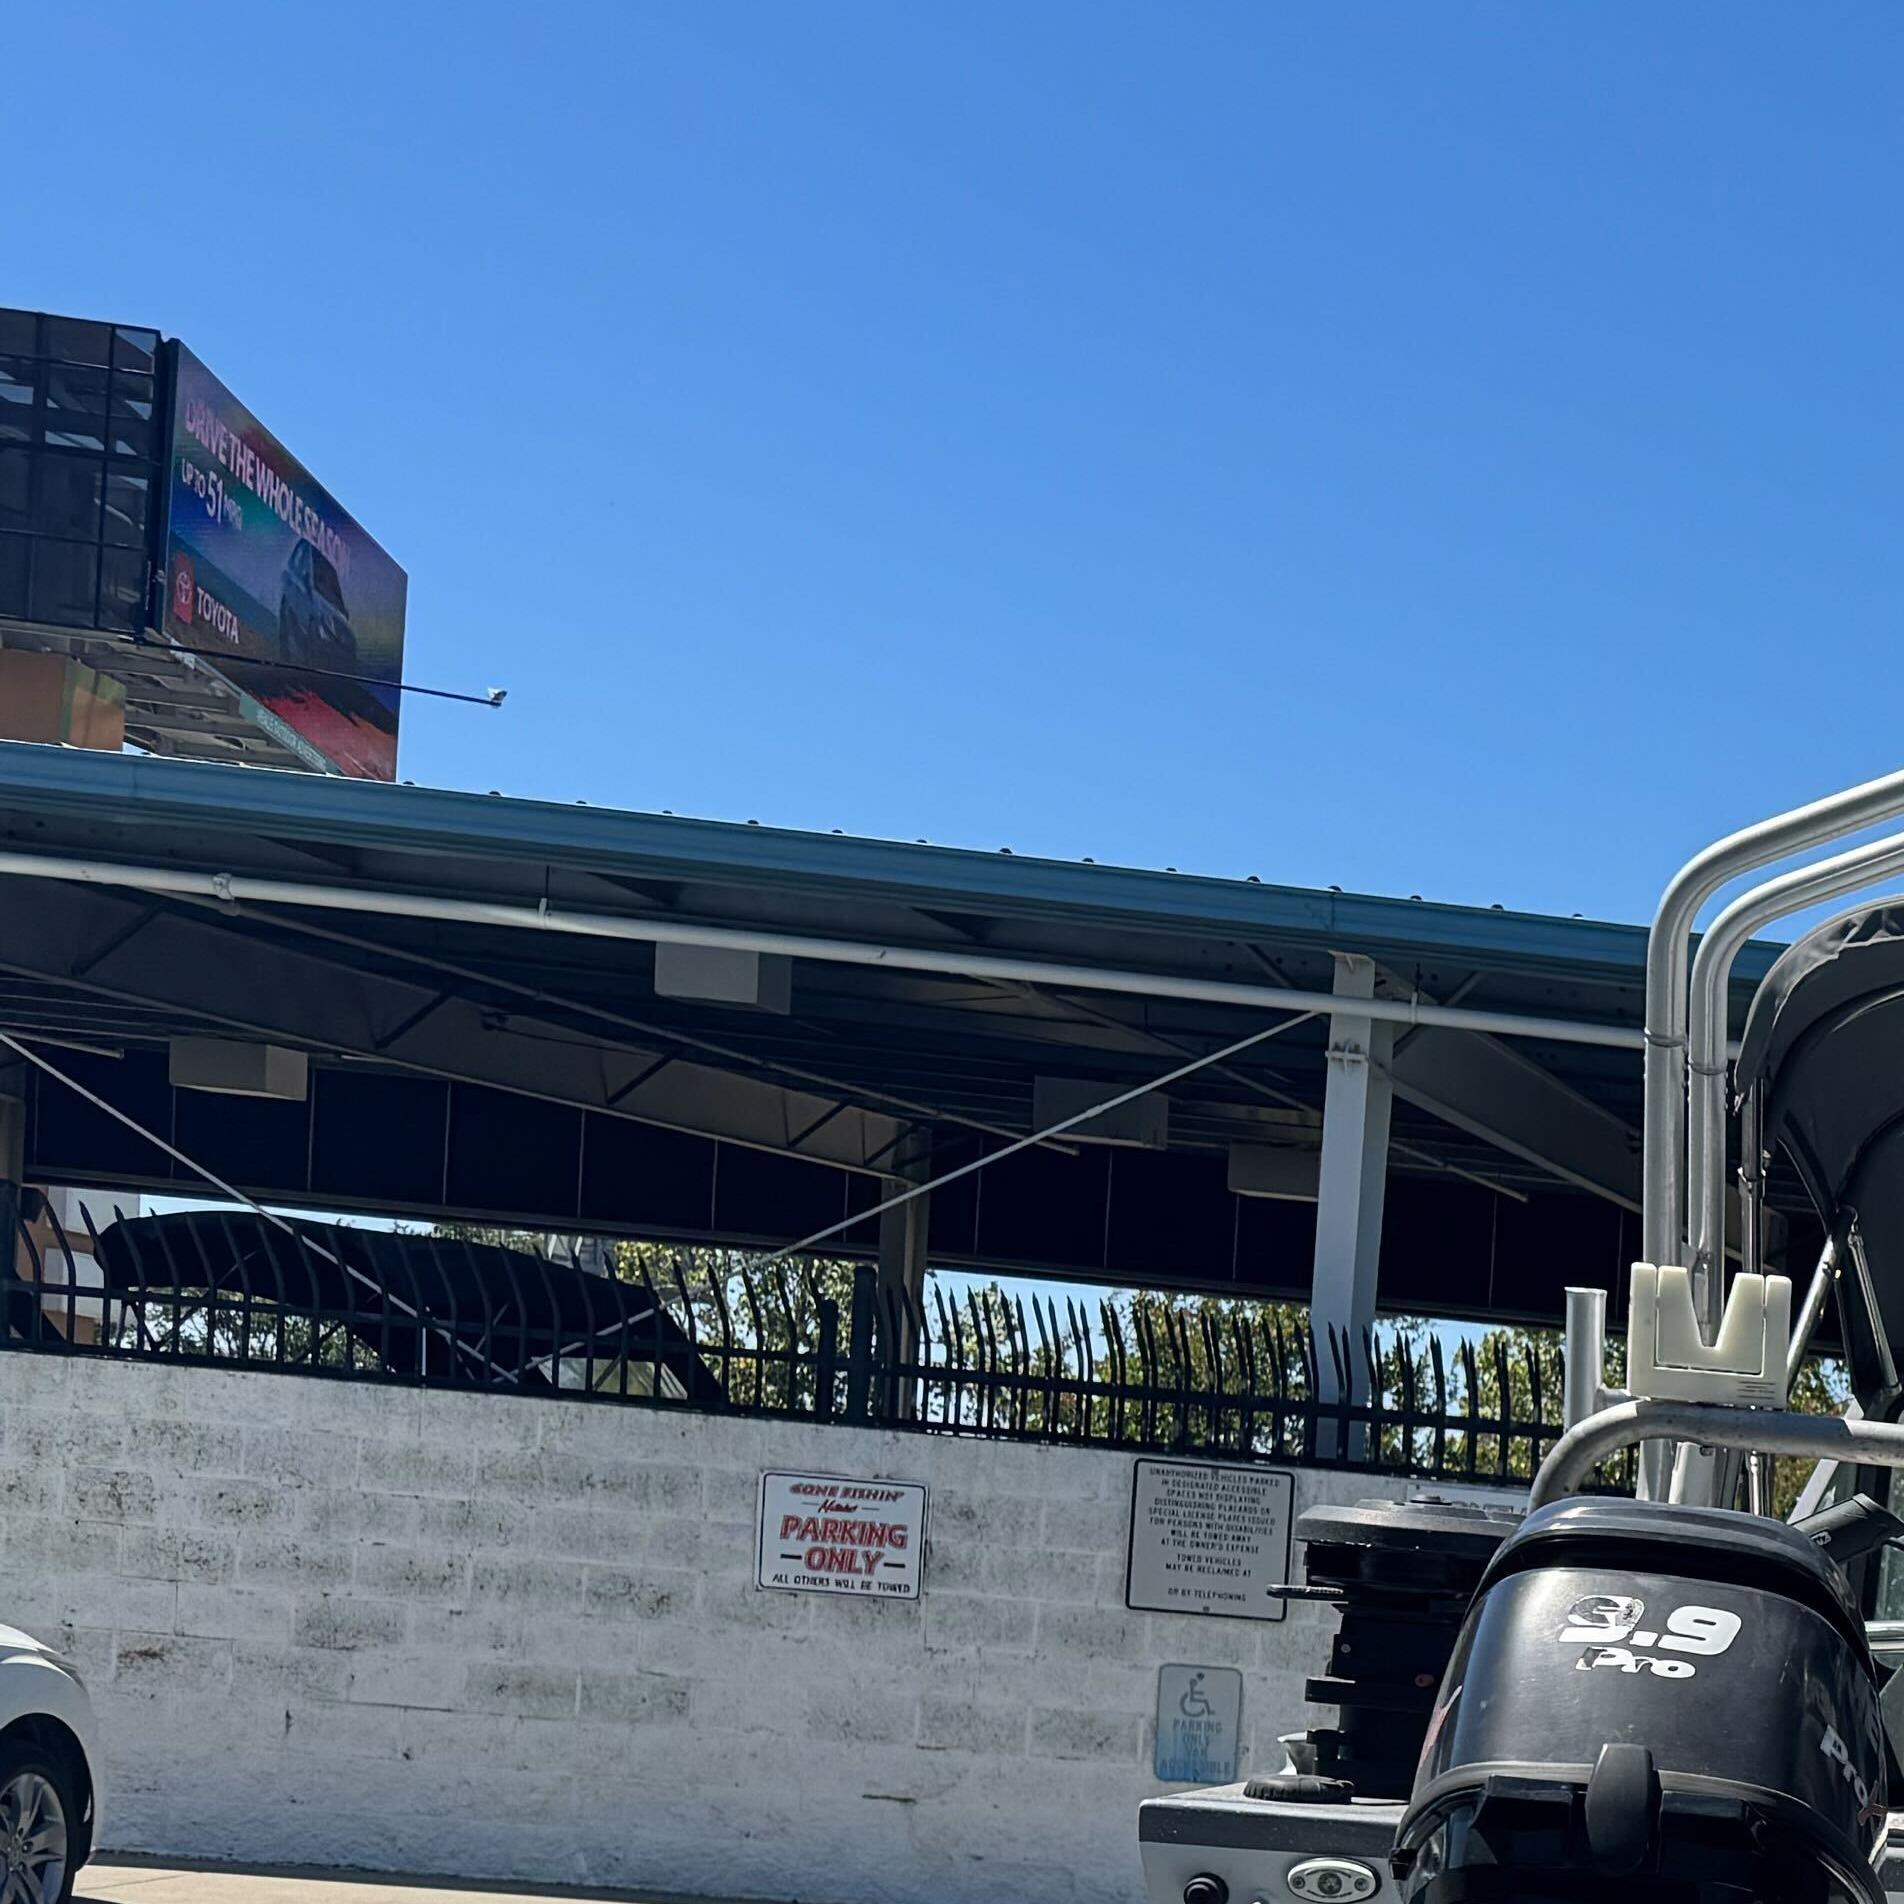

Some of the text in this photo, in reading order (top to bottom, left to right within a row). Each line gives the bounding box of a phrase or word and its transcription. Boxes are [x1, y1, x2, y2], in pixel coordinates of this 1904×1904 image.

[230, 432, 255, 491] THE
[206, 471, 224, 525] 51
[196, 586, 240, 645] TOYOTA
[790, 1483, 840, 1498] GONE
[779, 1514, 909, 1550] PARKING
[804, 1546, 885, 1576] ONLY
[772, 1574, 911, 1594] ALL OTHERS WILL BE TOWED
[1558, 1594, 1742, 1656] 9.9
[1575, 1646, 1696, 1679] Pro
[1172, 1718, 1223, 1734] PARKING
